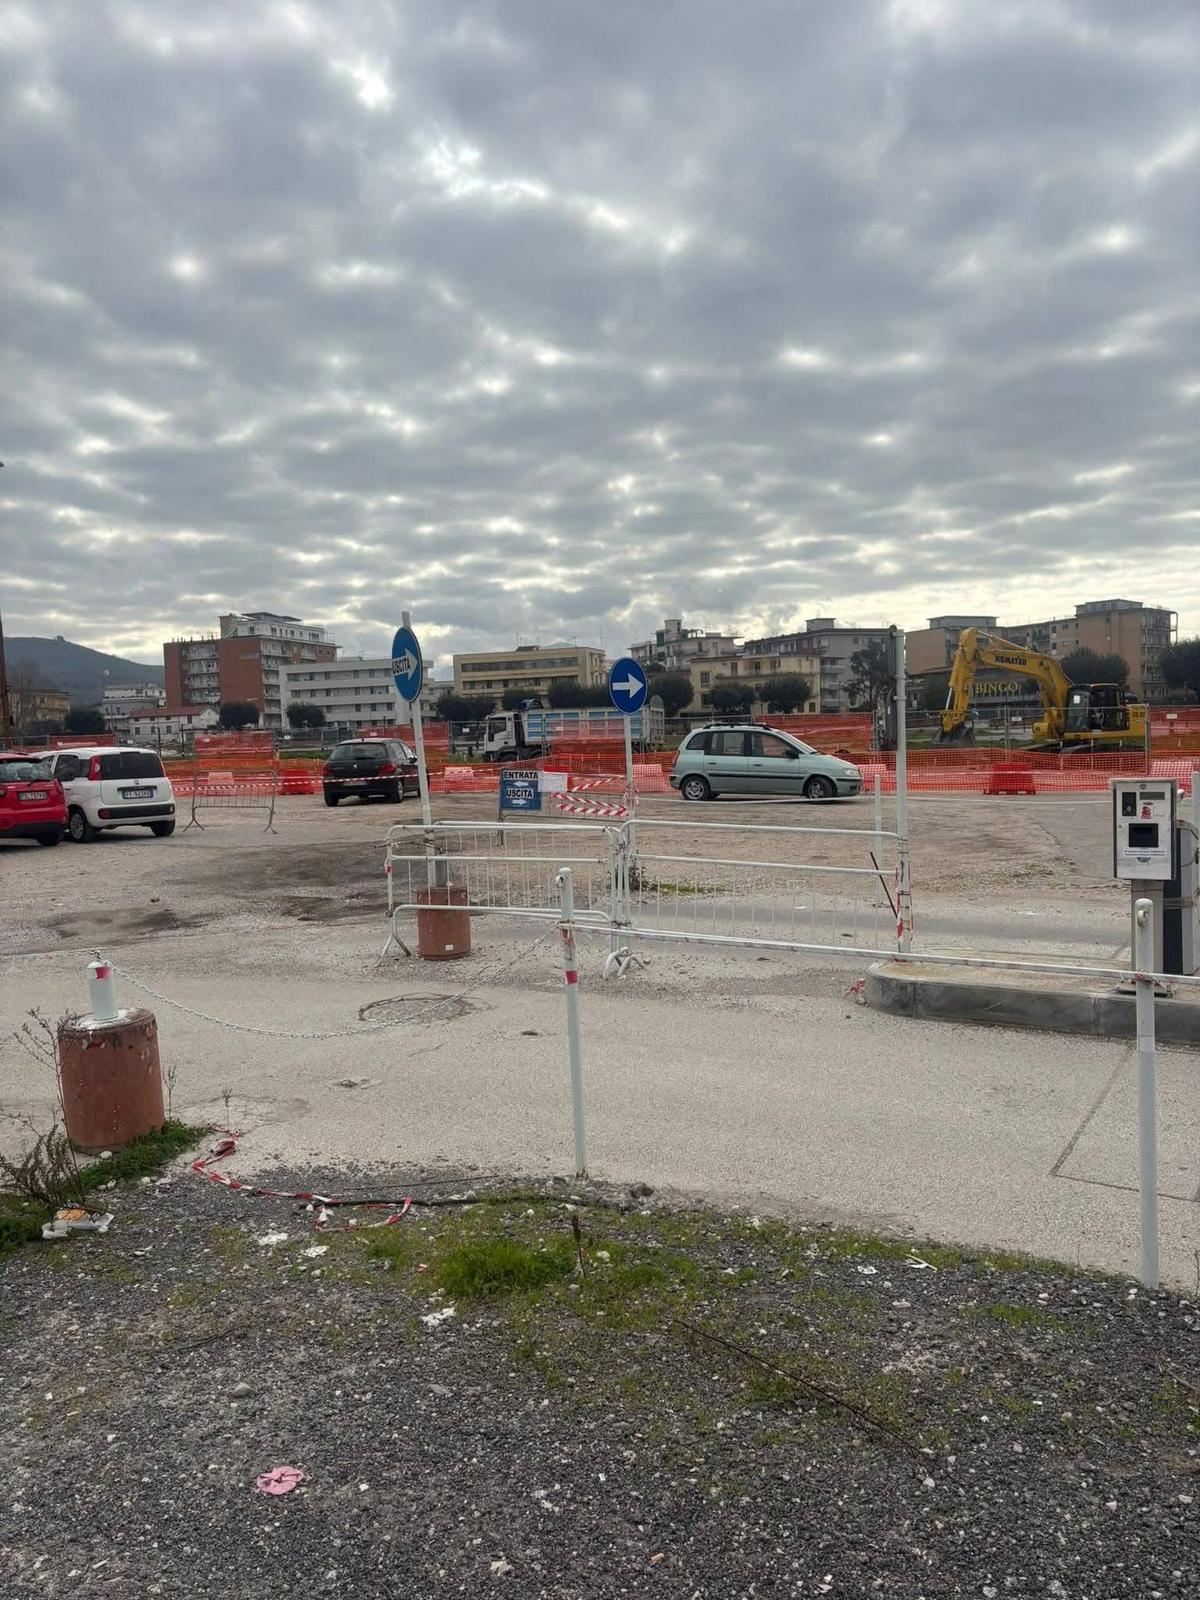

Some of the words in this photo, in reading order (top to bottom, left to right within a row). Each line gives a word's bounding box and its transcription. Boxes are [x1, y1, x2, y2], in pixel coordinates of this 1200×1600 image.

[995, 655, 1027, 666] KOMATSU
[975, 682, 1018, 694] BINGO
[504, 771, 538, 779] ENTRATA
[506, 789, 532, 798] USCITA
